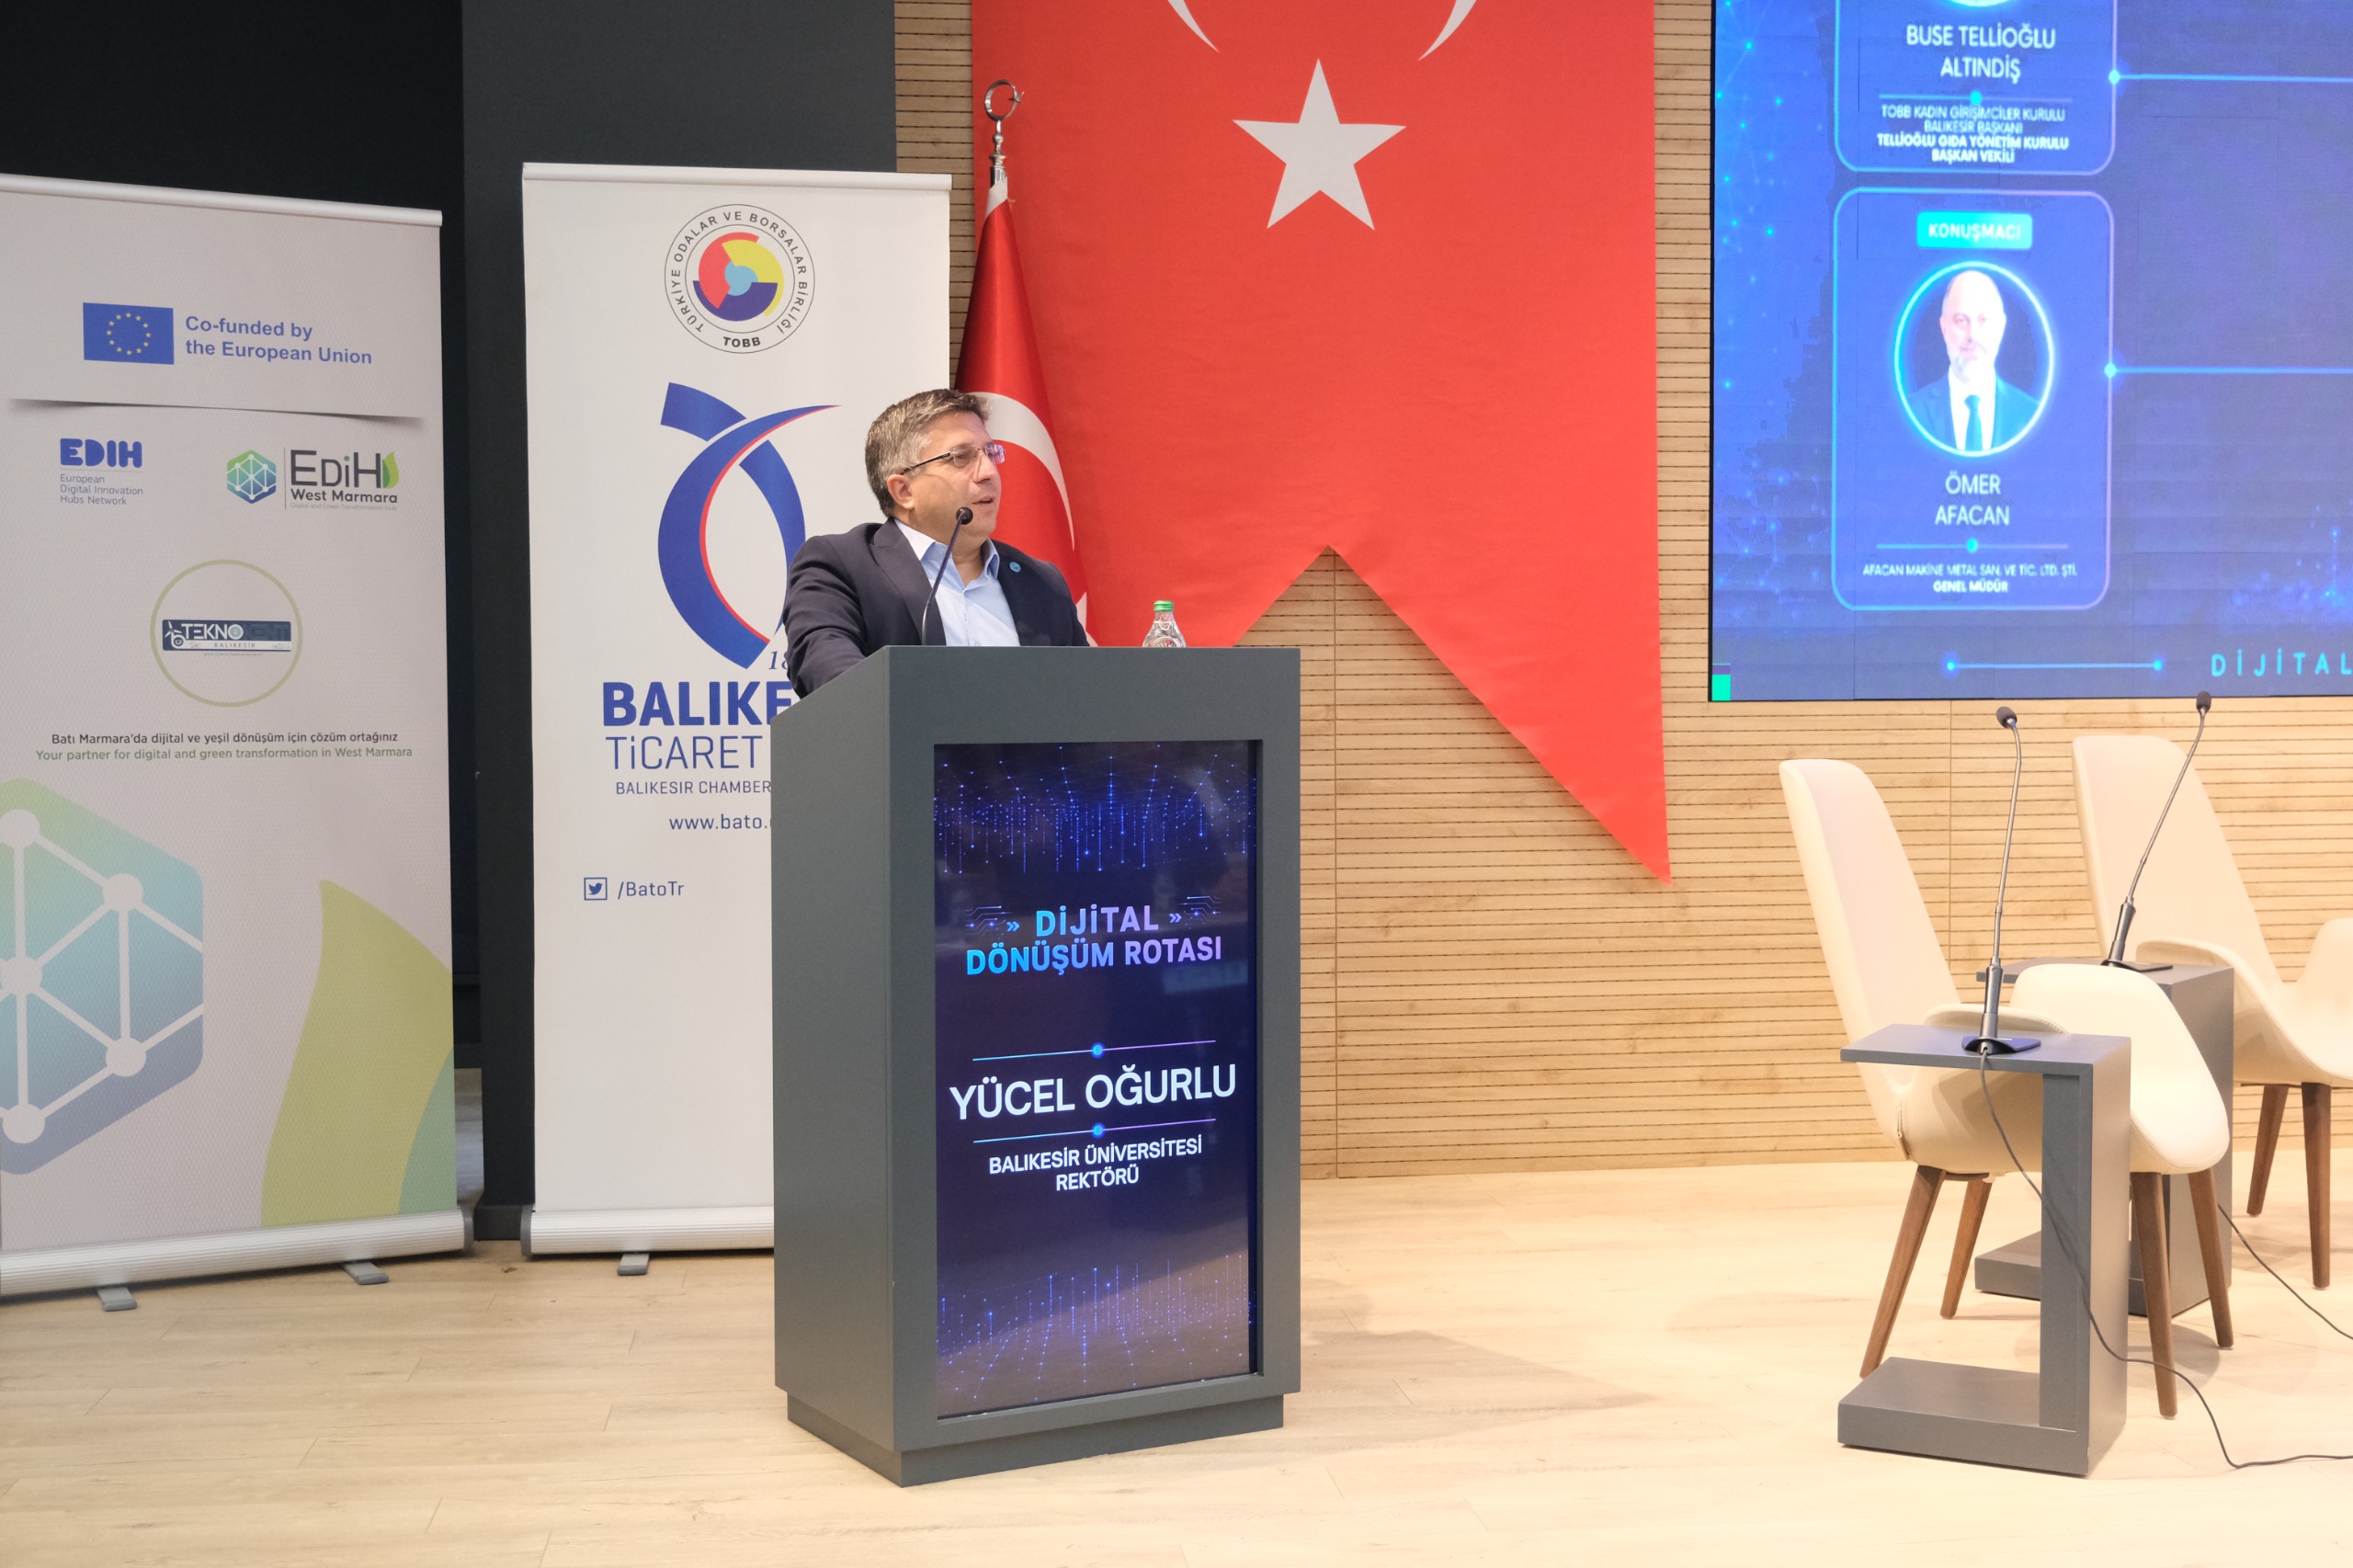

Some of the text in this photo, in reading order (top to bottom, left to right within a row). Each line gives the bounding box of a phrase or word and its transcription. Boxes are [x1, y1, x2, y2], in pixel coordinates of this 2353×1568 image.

[1906, 23, 2056, 49] BUSE TELLİOĞLU
[1939, 55, 2021, 85] ALTINDİŞ
[1881, 104, 1912, 119] TOBB
[1914, 105, 1948, 119] KADIN
[2022, 107, 2065, 121] KURULU
[1877, 131, 1937, 147] TELLİOĞLU
[1969, 133, 2021, 149] YÖNETİM
[2023, 136, 2069, 150] KURULU
[1931, 148, 1978, 165] BAŞKAN
[722, 211, 742, 222] VE
[674, 215, 718, 263] ODALAR
[1927, 222, 2021, 242] KONUŞMACI
[749, 212, 806, 275] BORSALAR
[671, 269, 704, 333] TÜRKİYE
[185, 315, 313, 342] Co-funded by
[722, 336, 761, 347] TOBB
[186, 340, 372, 364] the European Union
[60, 437, 142, 468] EDIH
[60, 474, 105, 484] European
[1945, 470, 2001, 494] ÖMER
[60, 484, 143, 495] Digital Innovation
[290, 488, 397, 503] West Marmara
[60, 495, 127, 506] Hubs Network
[1934, 505, 2010, 526] AFACAN
[1862, 563, 1904, 576] AFACAN
[1947, 563, 1977, 576] METAL
[1979, 563, 2002, 576] SAN.
[2004, 563, 2017, 577] VE
[1933, 578, 2009, 593] GENEL MÜDÜR
[2211, 647, 2353, 677] DİJİTAL
[51, 732, 397, 745] Batı Marmara'da dijital ve yeşil dönüşüm için çözüm ortağınız
[36, 747, 413, 762] Your partner for digital and green transformation in West Marmara
[616, 780, 771, 795] BALIKESIR CHAMBER
[669, 813, 771, 829] www.bato.
[618, 881, 685, 900] /BatoTr
[1035, 904, 1159, 937] DİJİTAL
[966, 936, 1222, 975] DÖNÜŞÜM ROTASI
[949, 1063, 1237, 1120] YÜCEL OĞURLU
[989, 1134, 1203, 1175] BALIKESİR ÜNİVERSİTESİ
[1056, 1165, 1140, 1191] REKTÖRÜ
